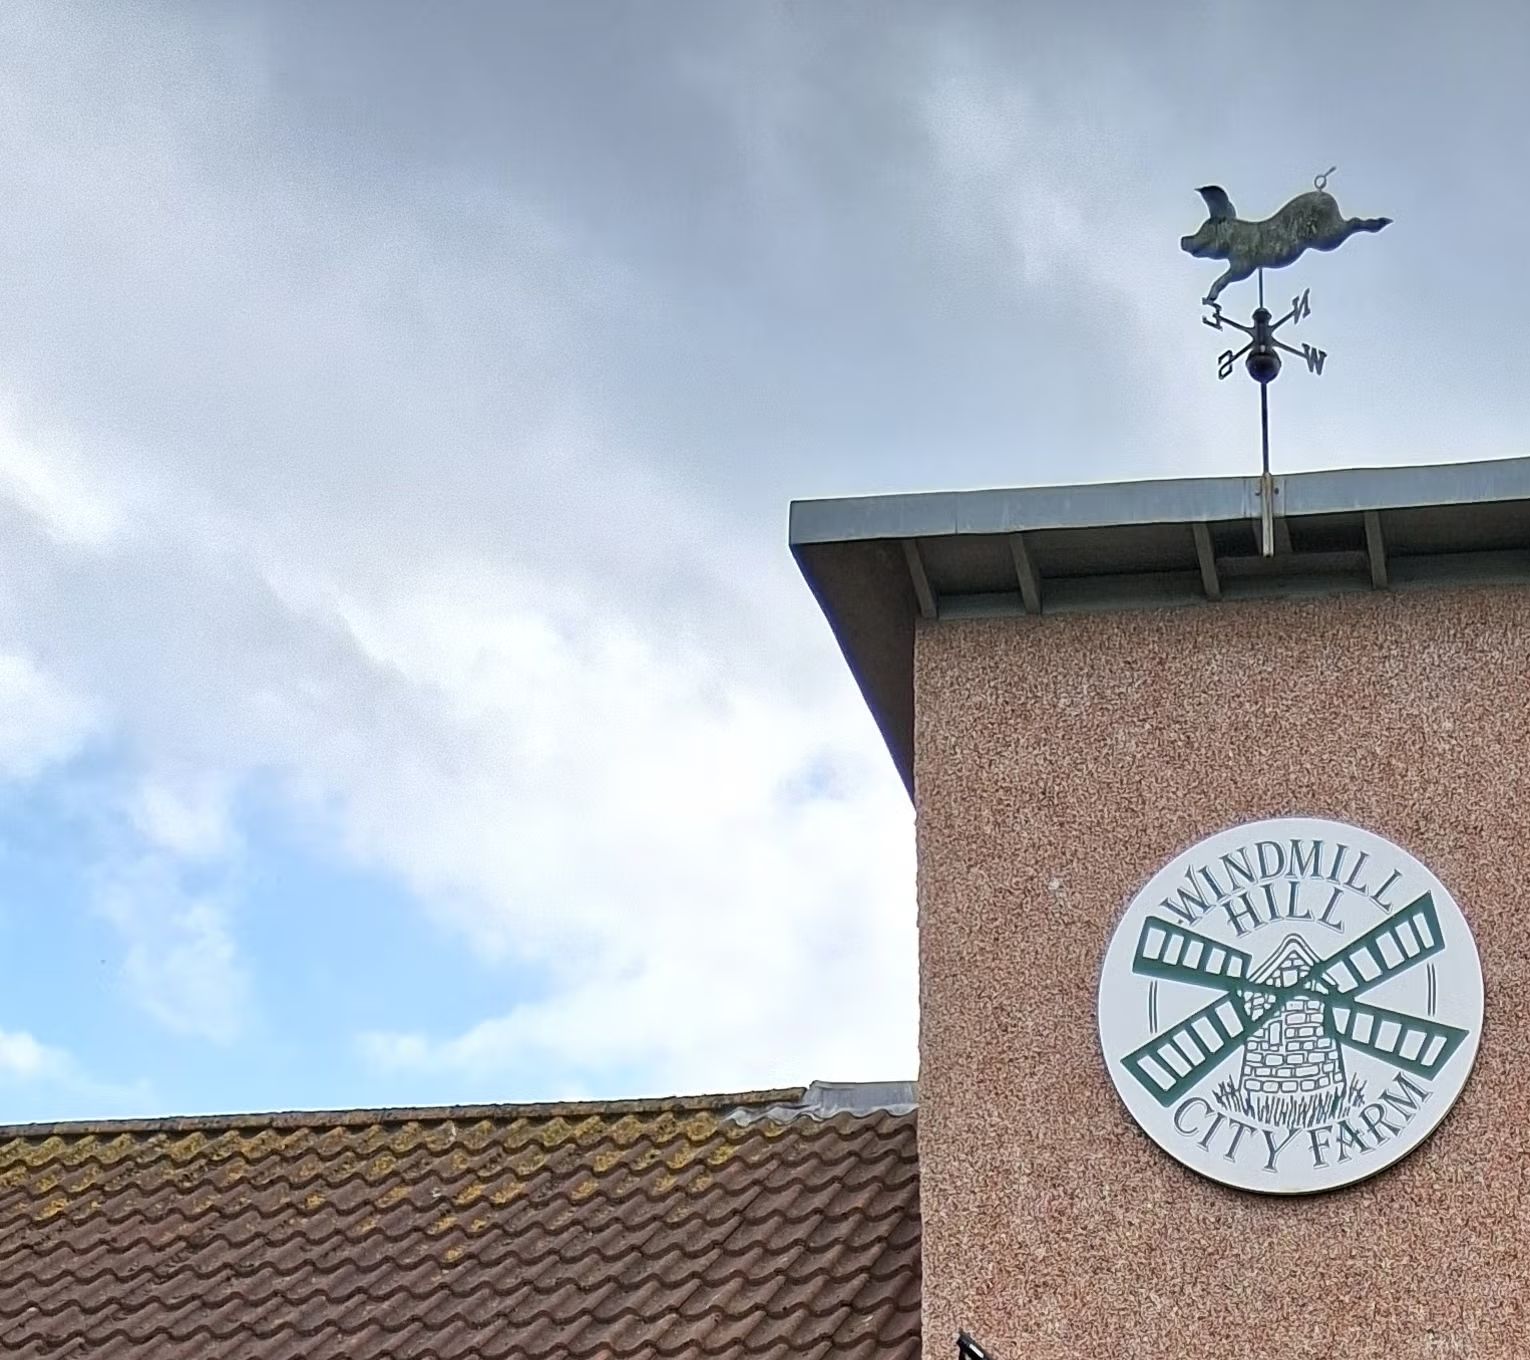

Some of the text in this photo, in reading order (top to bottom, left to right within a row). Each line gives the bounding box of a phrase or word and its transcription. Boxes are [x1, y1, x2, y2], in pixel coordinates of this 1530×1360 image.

[1160, 838, 1402, 927] WINDMILL
[1220, 880, 1345, 938] HILL
[1173, 1071, 1434, 1173] CITY FARM
